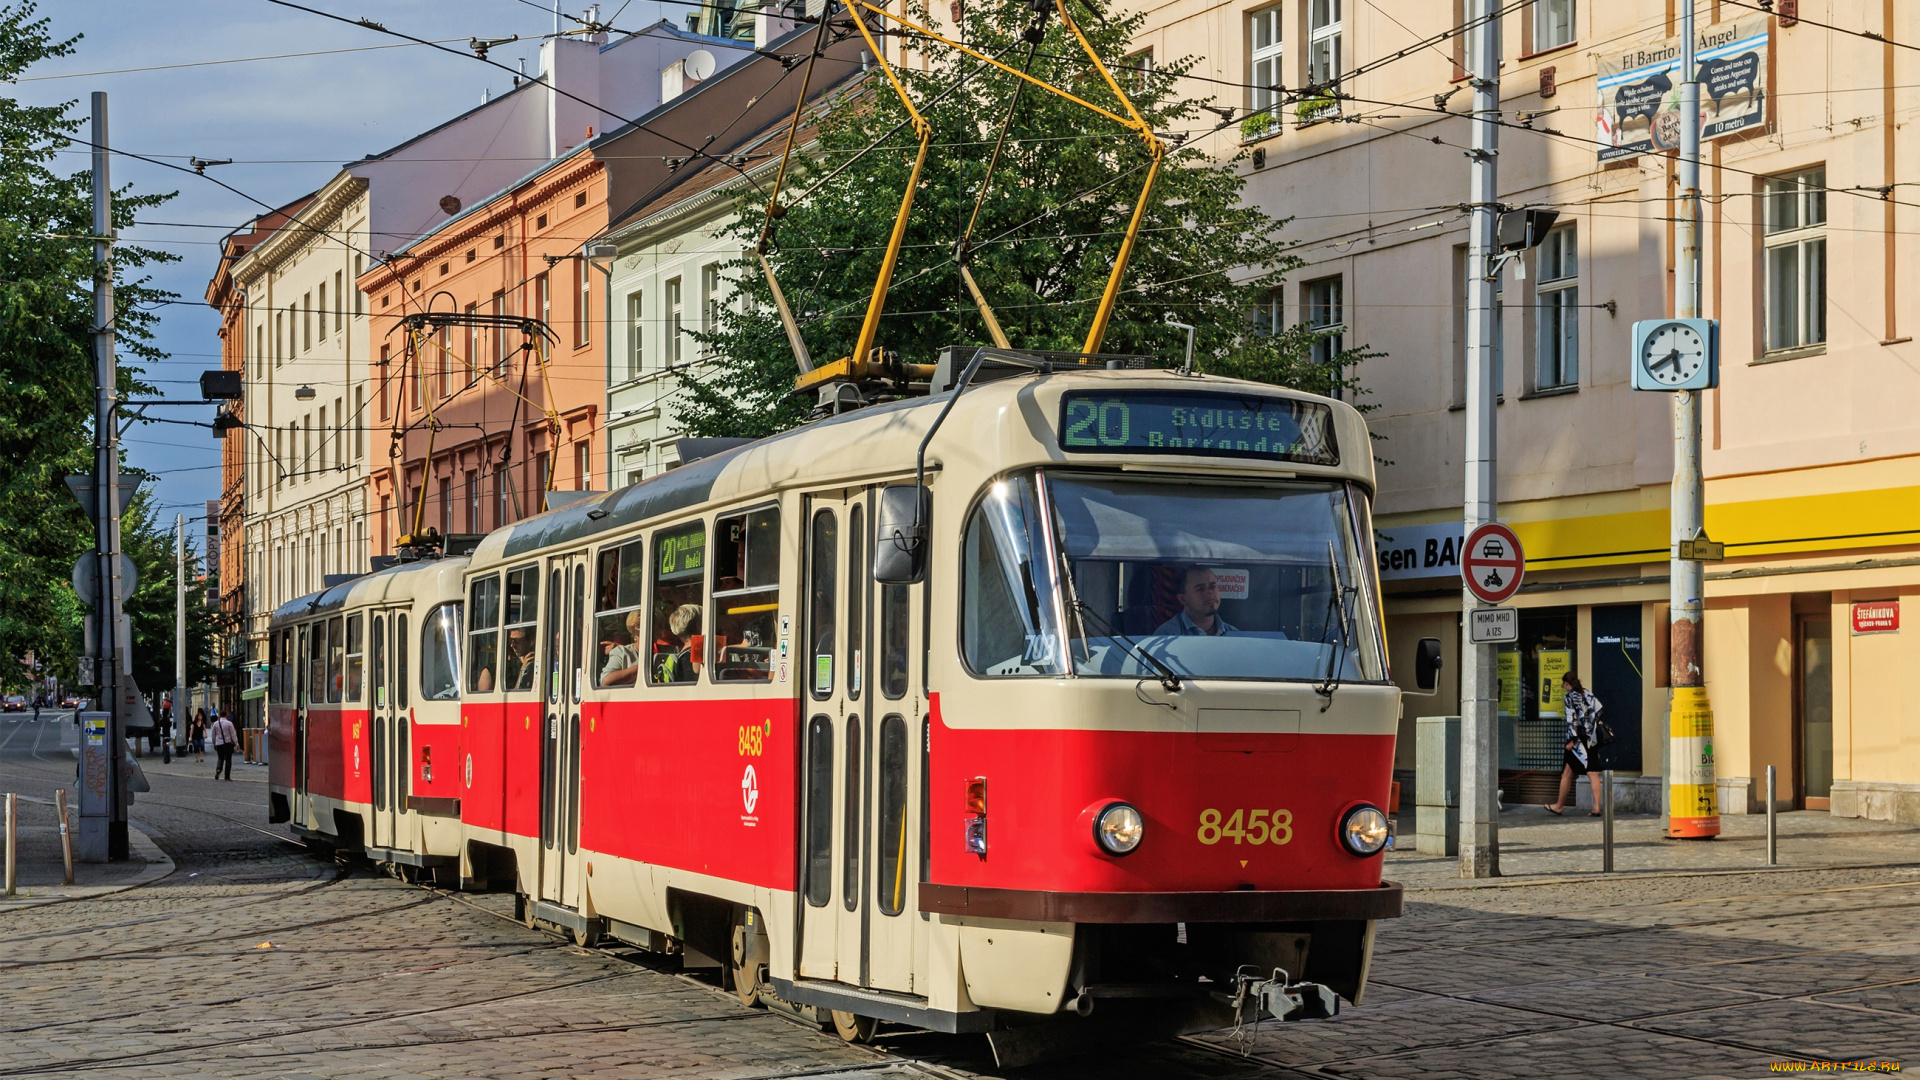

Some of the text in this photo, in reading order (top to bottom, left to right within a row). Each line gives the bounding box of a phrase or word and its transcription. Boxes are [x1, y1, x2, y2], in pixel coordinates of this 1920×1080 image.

[1622, 24, 1737, 70] El Barrio Ángel
[1661, 118, 1680, 132] Barri
[1662, 116, 1671, 124] El
[1715, 117, 1745, 133] 10 metrů
[1065, 397, 1130, 447] 20
[1171, 406, 1281, 431] Sídliště
[662, 537, 677, 574] 20
[1477, 612, 1510, 623] MIMO MHD
[1857, 606, 1894, 620] ŠTEFÁNIKOVA
[1486, 626, 1502, 637] A IZS
[1596, 636, 1621, 644] Raiffeisen
[738, 725, 763, 757] 8458
[1197, 808, 1293, 846] 8458
